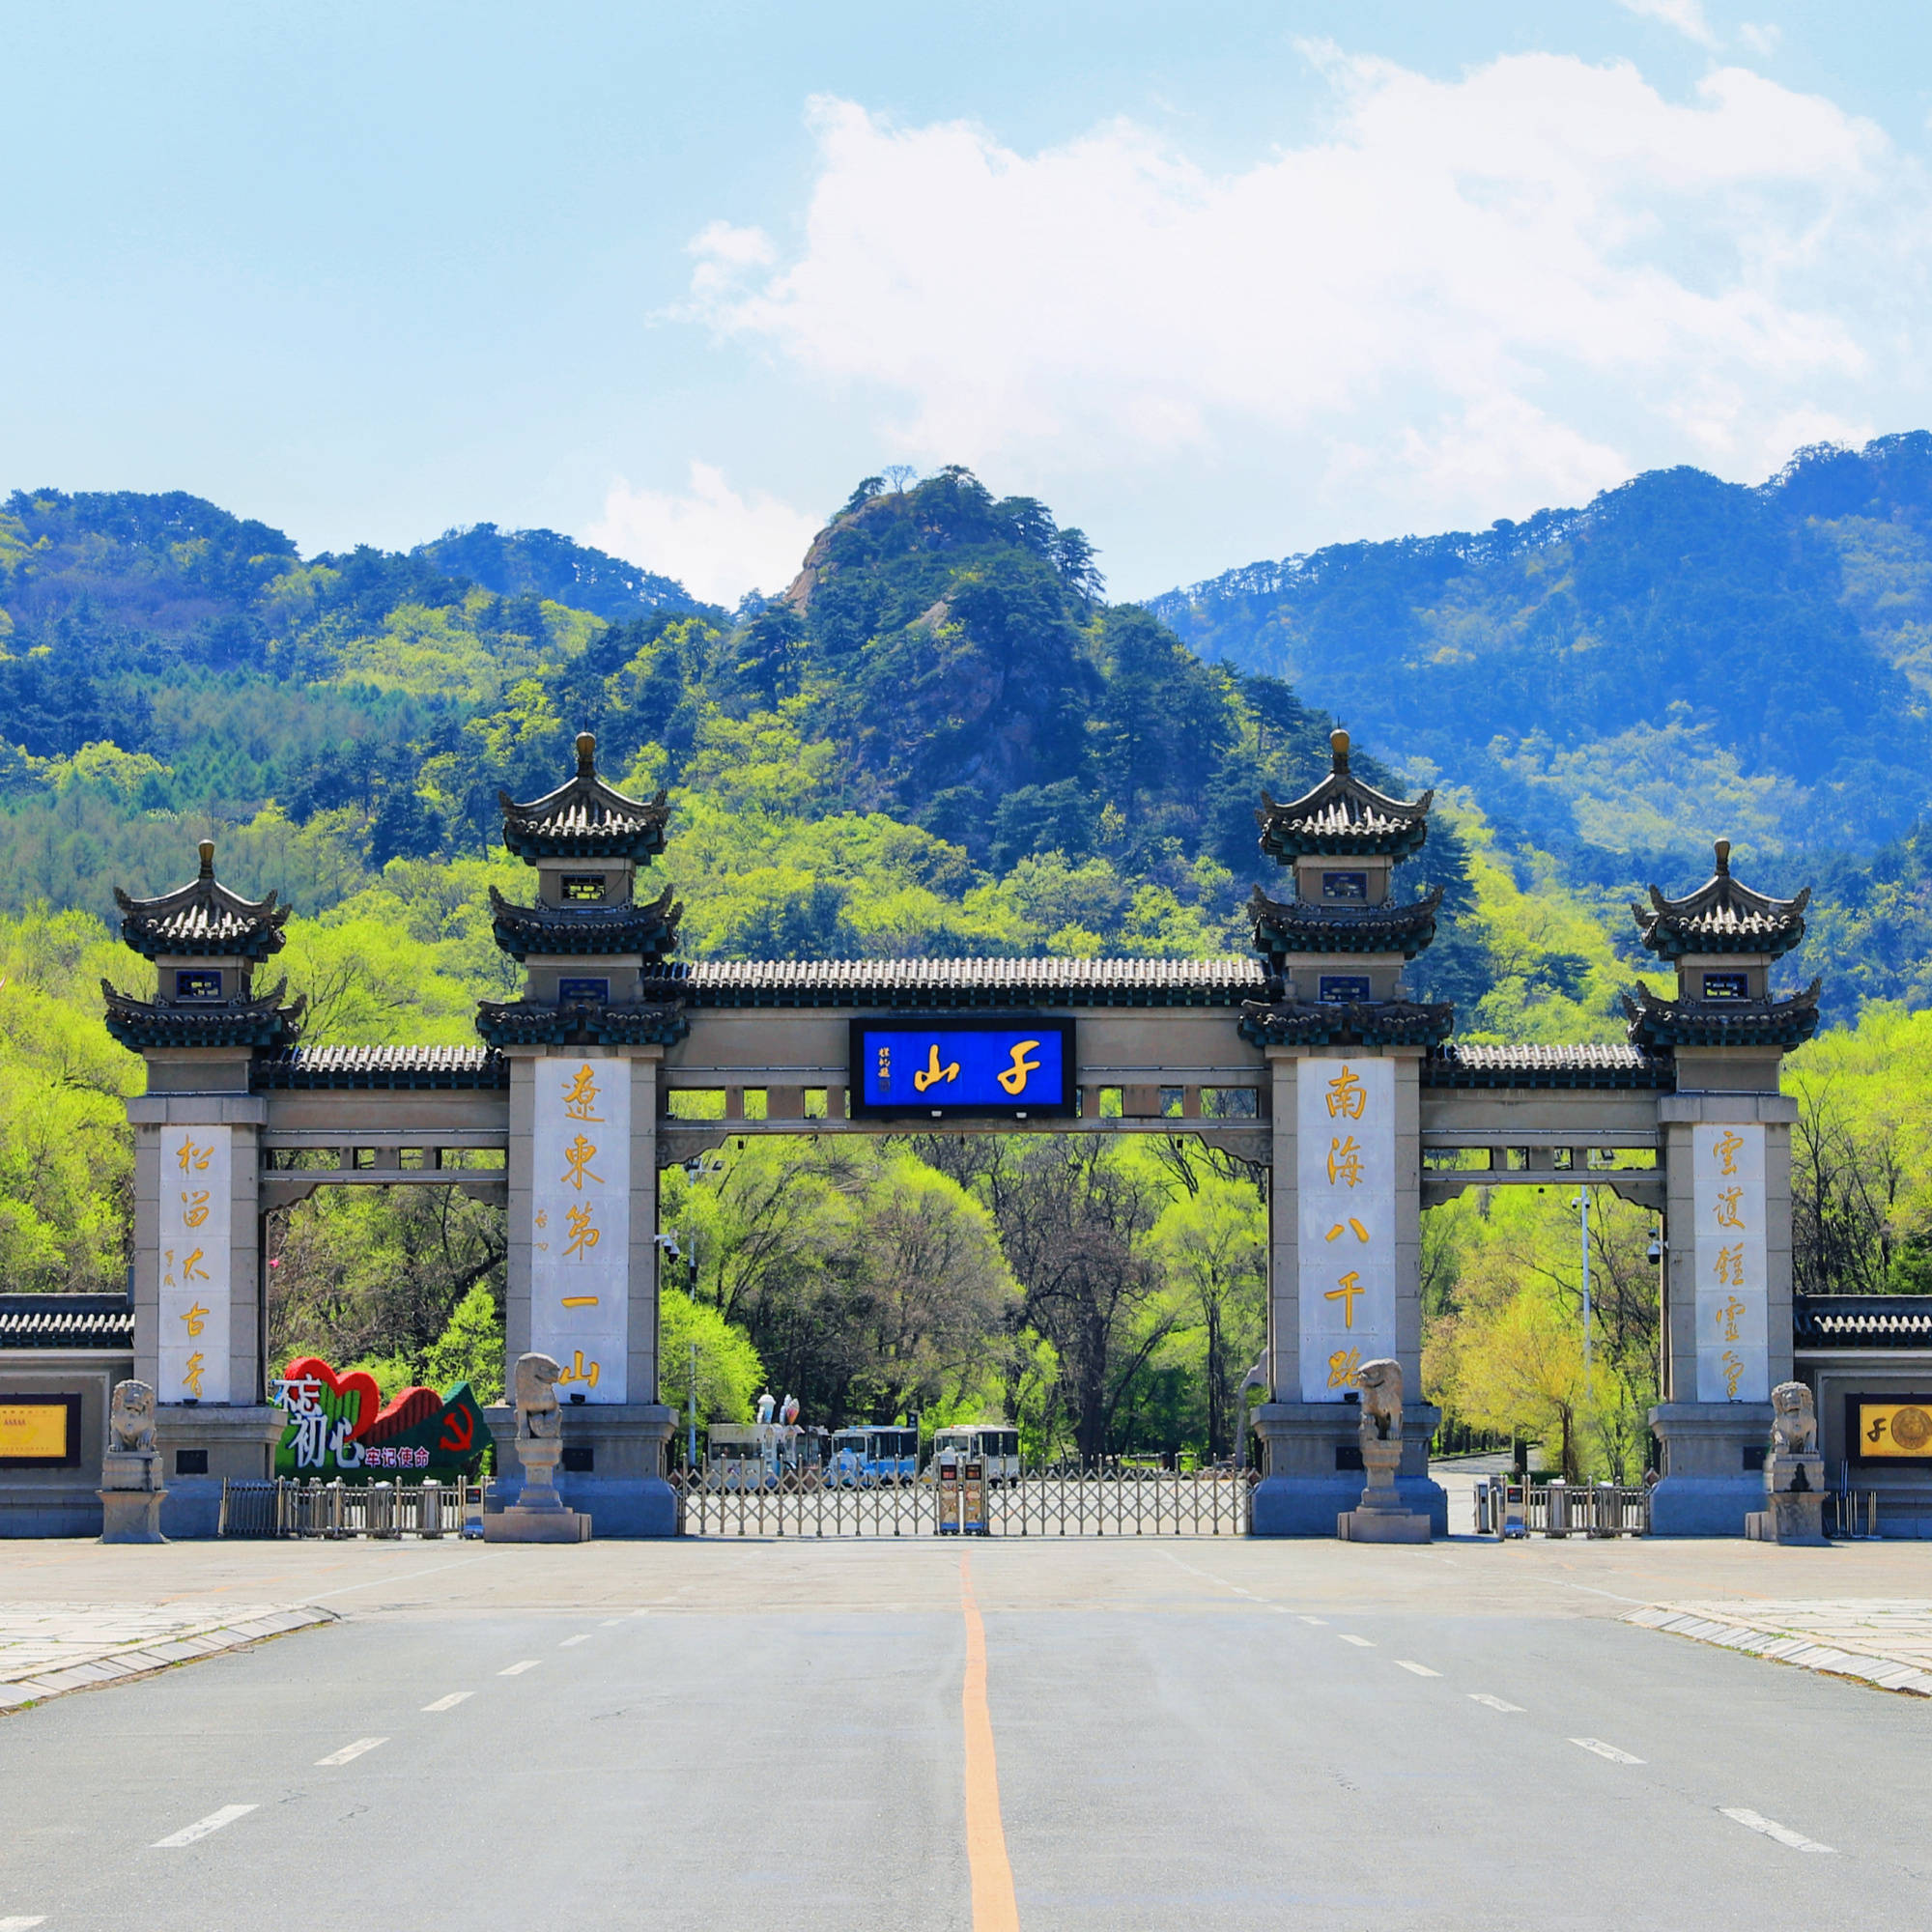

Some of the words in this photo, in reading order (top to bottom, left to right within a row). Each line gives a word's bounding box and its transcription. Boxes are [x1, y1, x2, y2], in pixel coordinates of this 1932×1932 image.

[913, 1039, 1040, 1095] 千山
[1324, 1065, 1370, 1389] 南海八千路
[289, 1412, 366, 1468] 初心
[365, 1447, 430, 1468] 牢记使命
